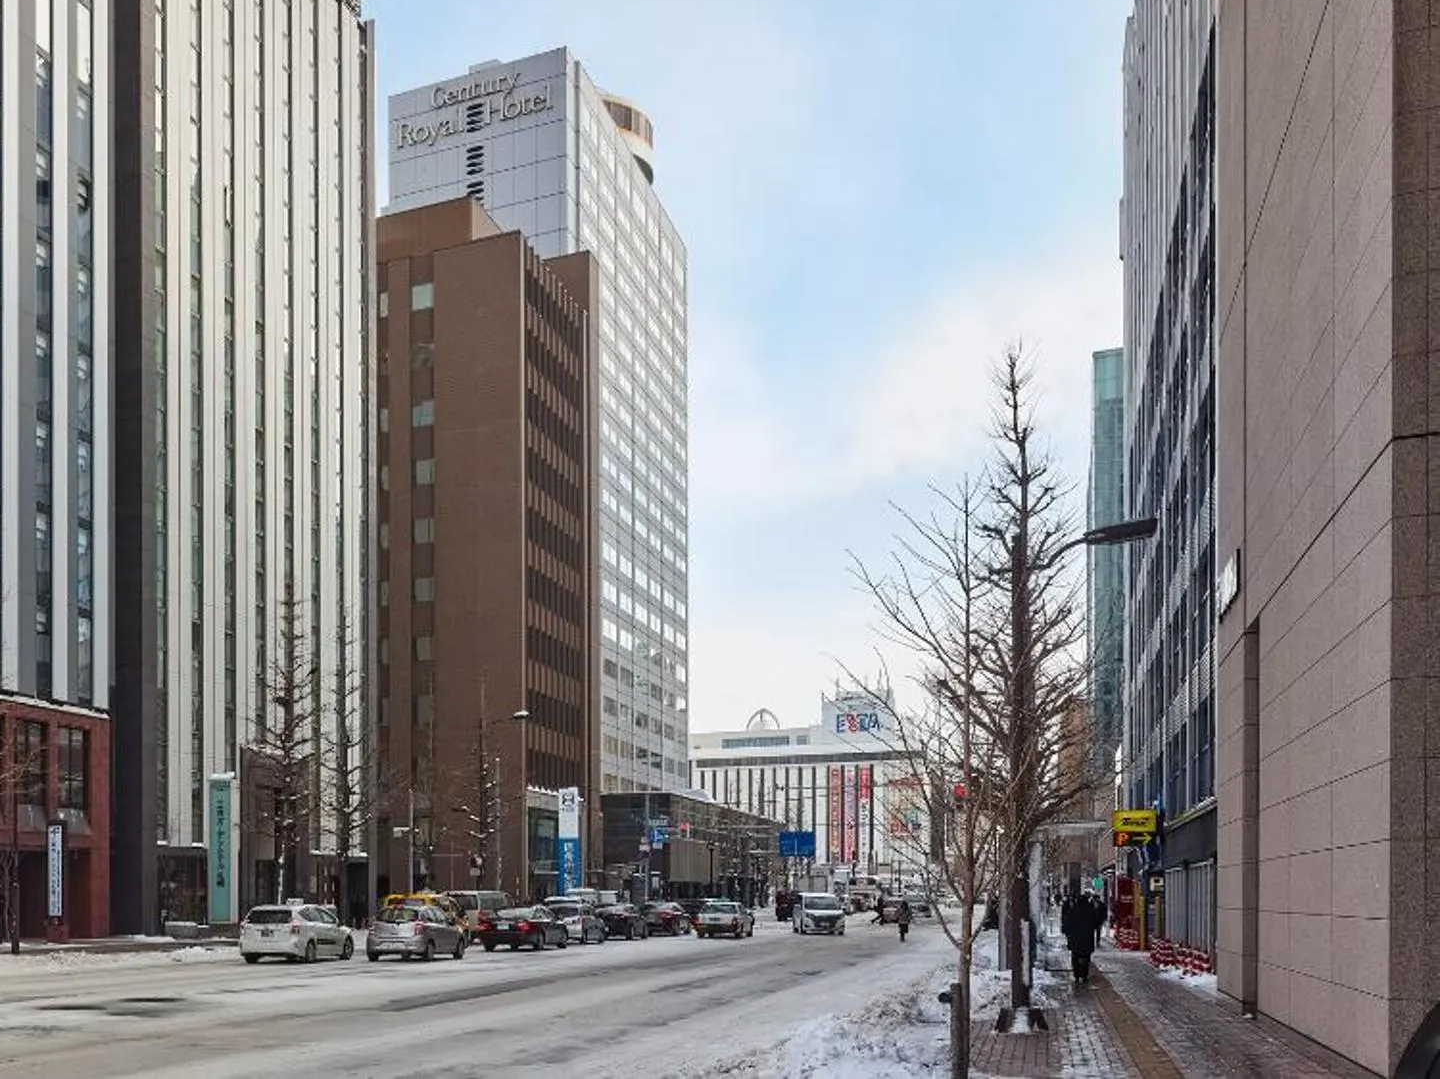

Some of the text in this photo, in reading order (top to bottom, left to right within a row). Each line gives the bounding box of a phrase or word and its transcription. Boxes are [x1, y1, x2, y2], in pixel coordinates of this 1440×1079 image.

[431, 72, 521, 109] Century
[396, 85, 554, 149] Royal Hotel
[1118, 832, 1129, 845] P
